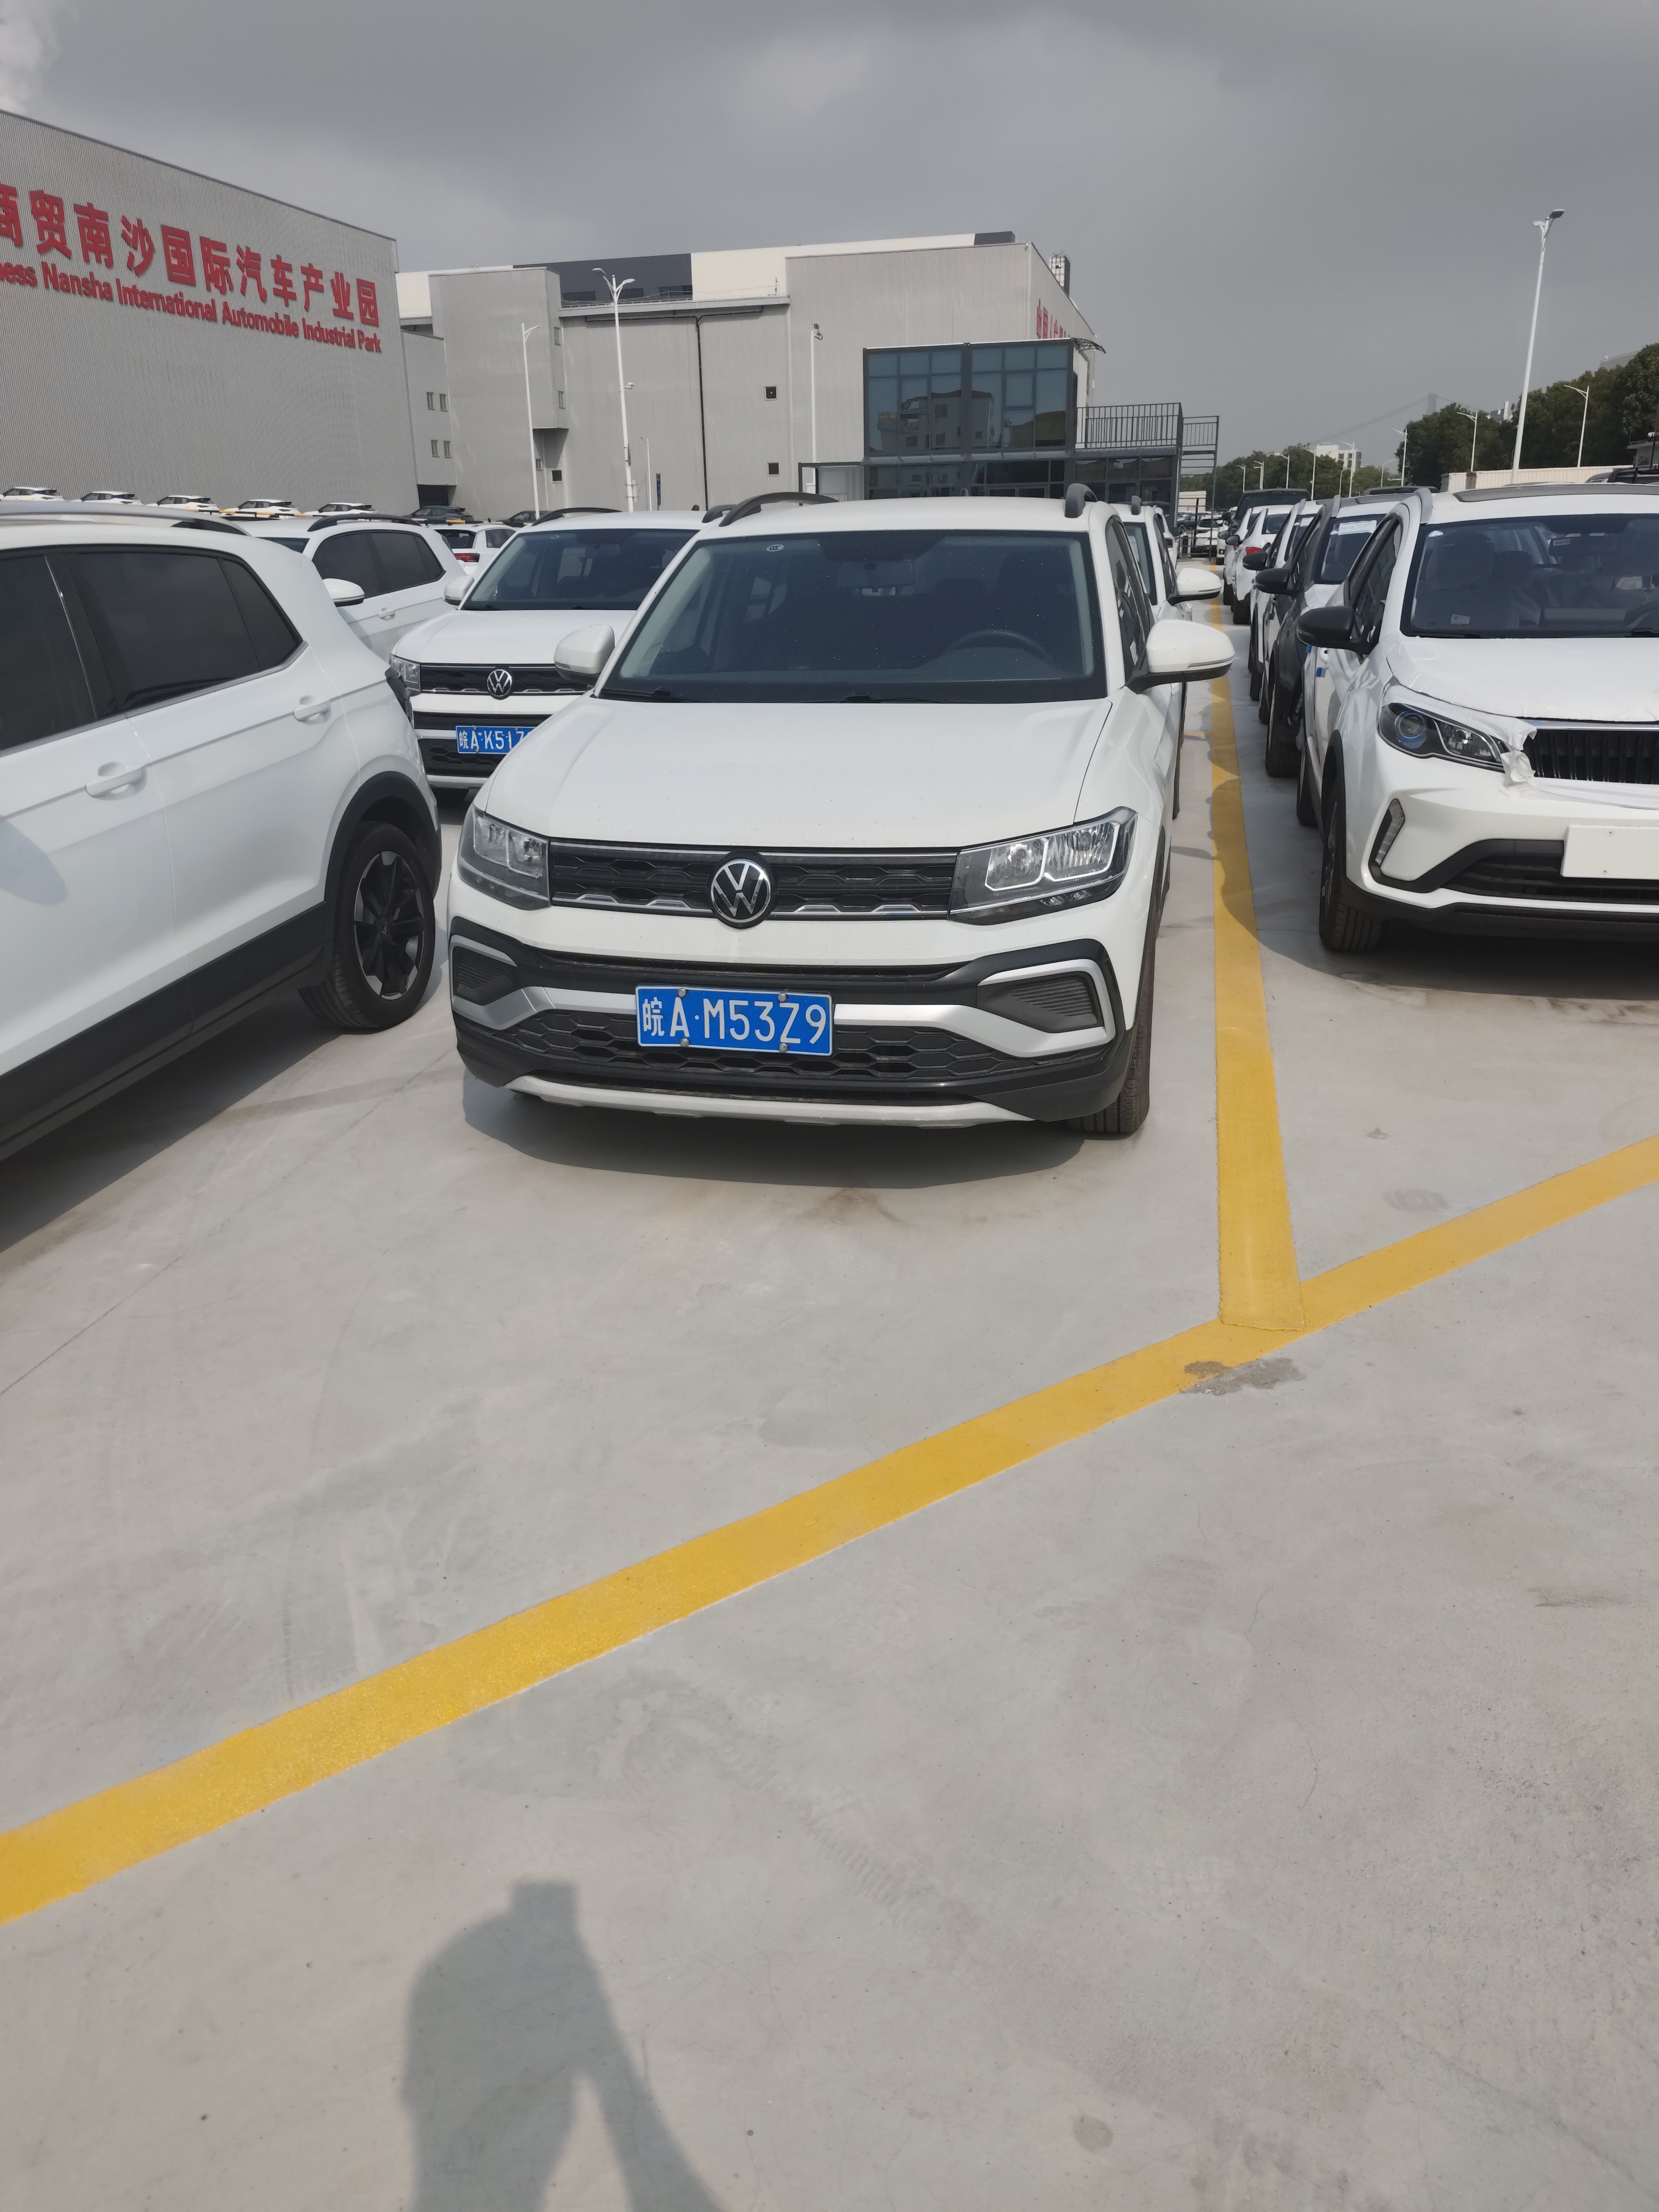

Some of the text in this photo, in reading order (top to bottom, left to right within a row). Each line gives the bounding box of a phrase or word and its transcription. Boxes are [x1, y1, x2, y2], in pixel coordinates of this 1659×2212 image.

[0, 261, 382, 354] ess Nansha International Automobile Industrial Park
